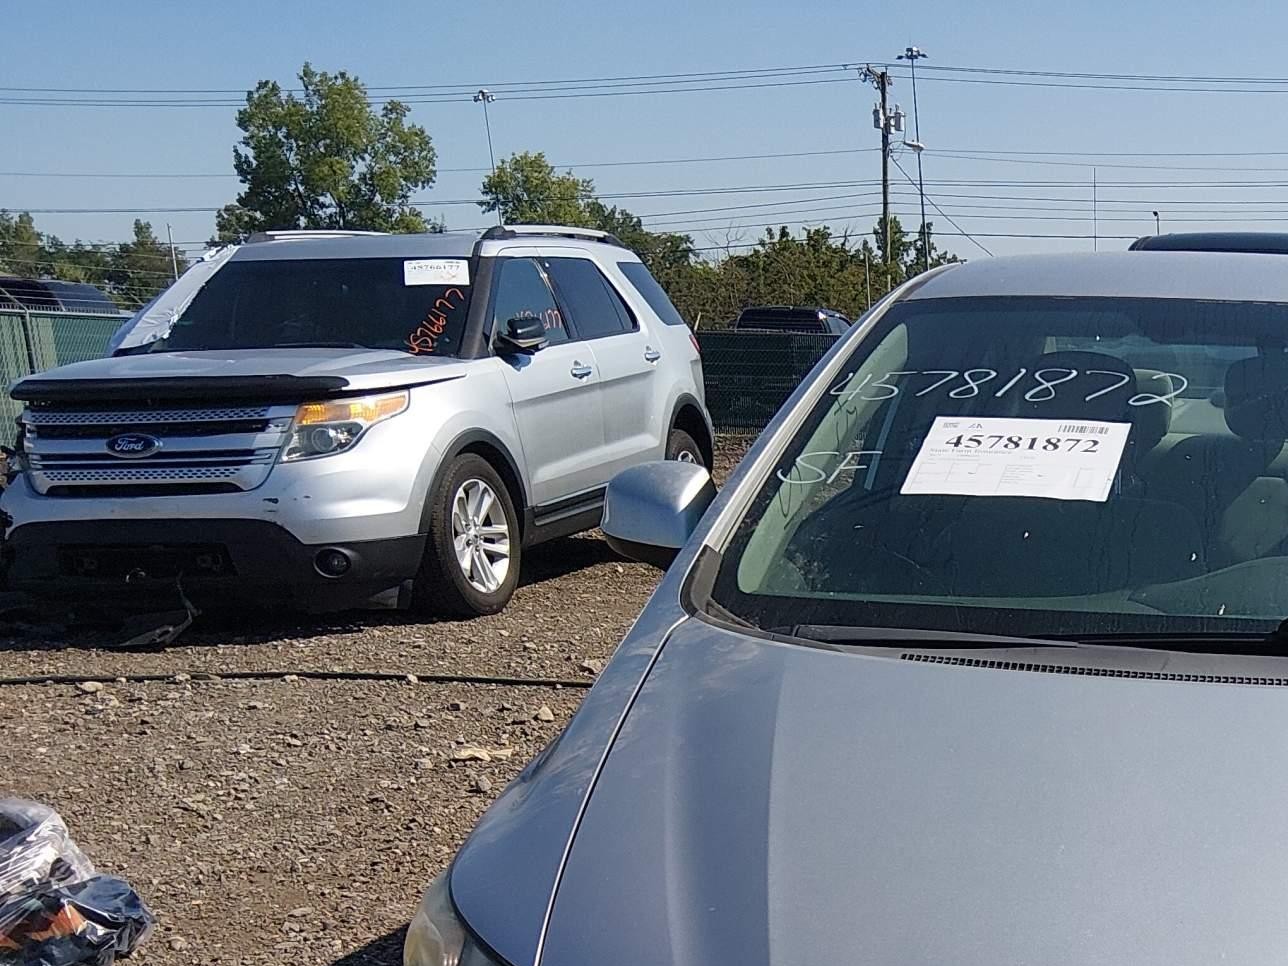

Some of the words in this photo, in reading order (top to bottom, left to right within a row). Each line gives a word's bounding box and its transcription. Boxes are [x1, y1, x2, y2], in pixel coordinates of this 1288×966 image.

[409, 287, 465, 354] 45766177
[829, 368, 1188, 407] 45781872
[115, 438, 144, 451] Ford
[945, 433, 1100, 453] 45781872
[776, 450, 883, 485] SF
